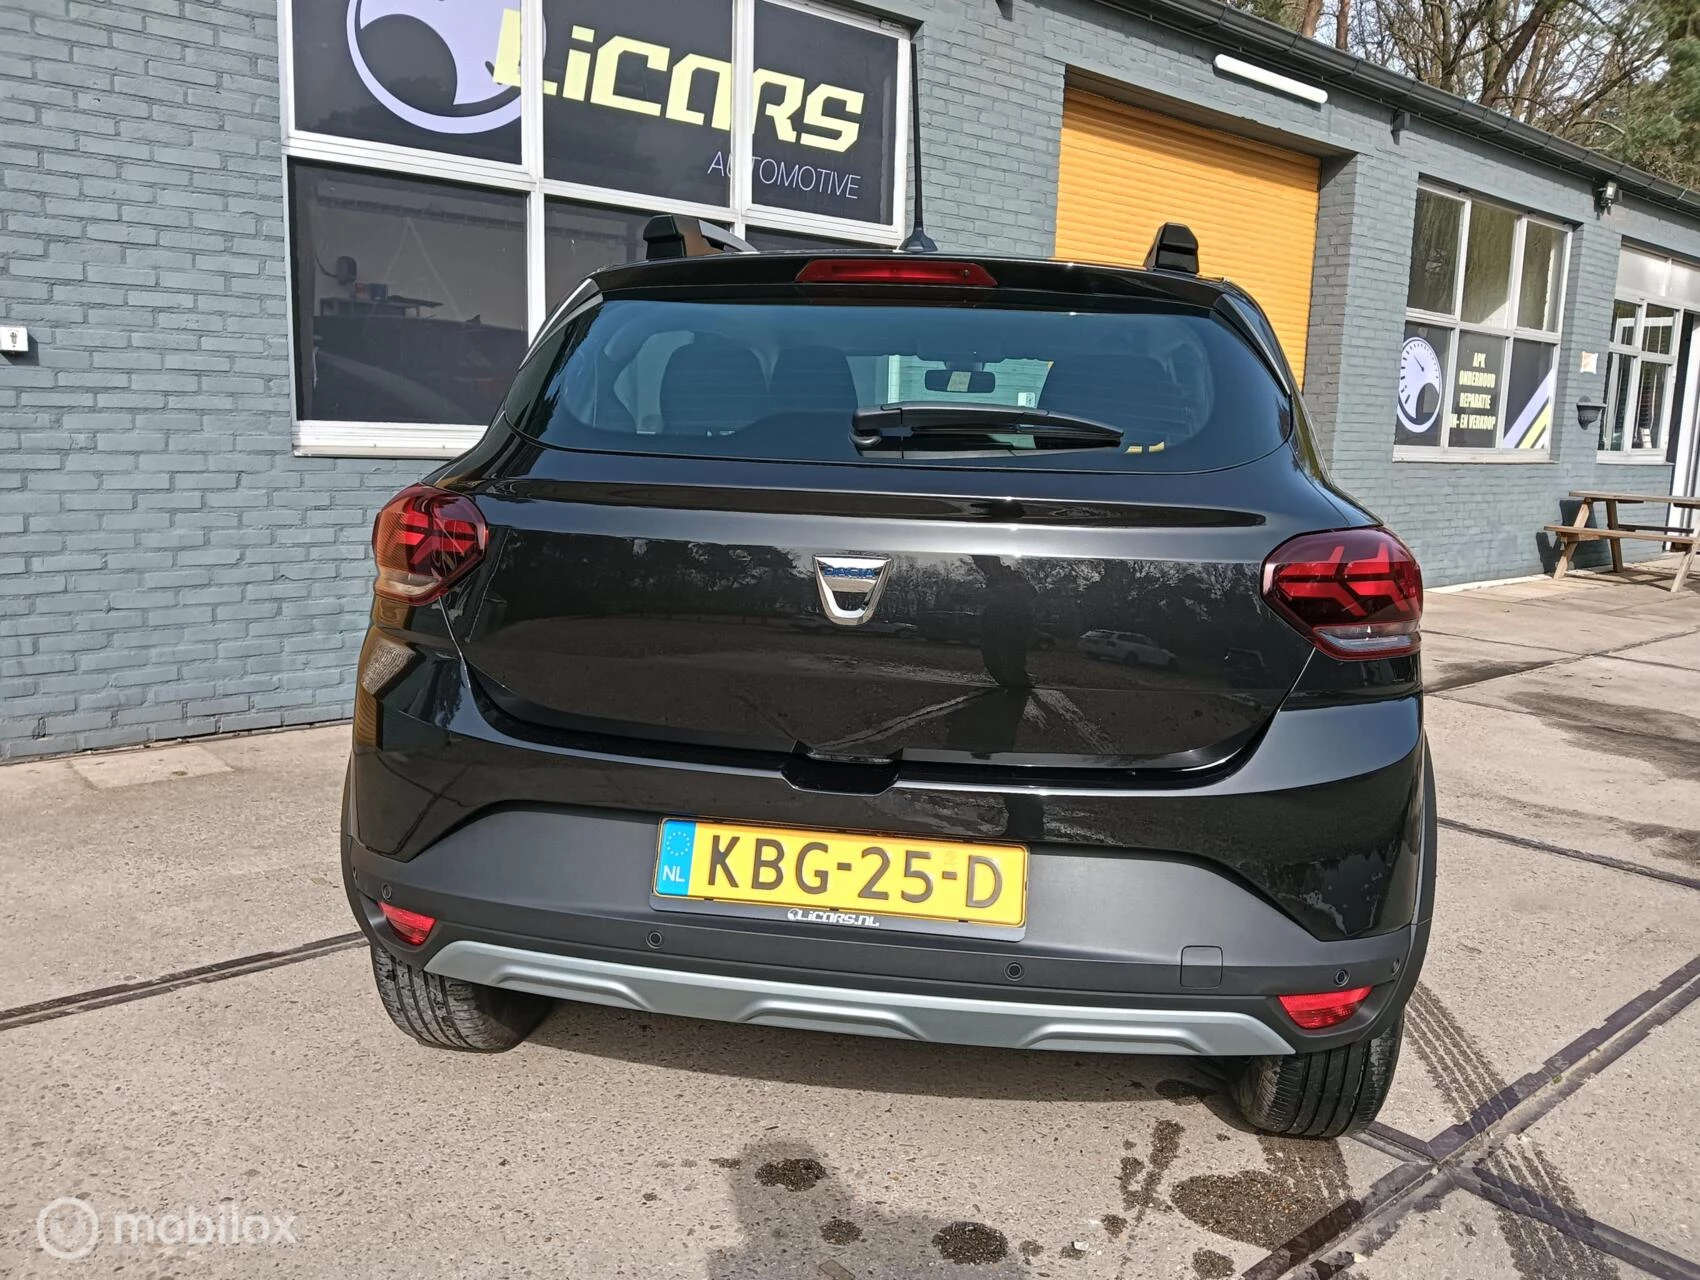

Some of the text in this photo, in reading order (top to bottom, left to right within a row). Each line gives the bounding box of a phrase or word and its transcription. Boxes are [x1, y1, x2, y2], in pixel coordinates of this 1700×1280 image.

[1472, 352, 1486, 368] APK
[1459, 370, 1496, 388] ONDERHOUD
[1459, 392, 1491, 409] REPARATIE
[1460, 413, 1469, 429] EN
[1469, 414, 1496, 431] VERKOOP
[824, 567, 876, 578] DACIA
[662, 864, 685, 883] NL
[707, 834, 1002, 909] KBG-25-D
